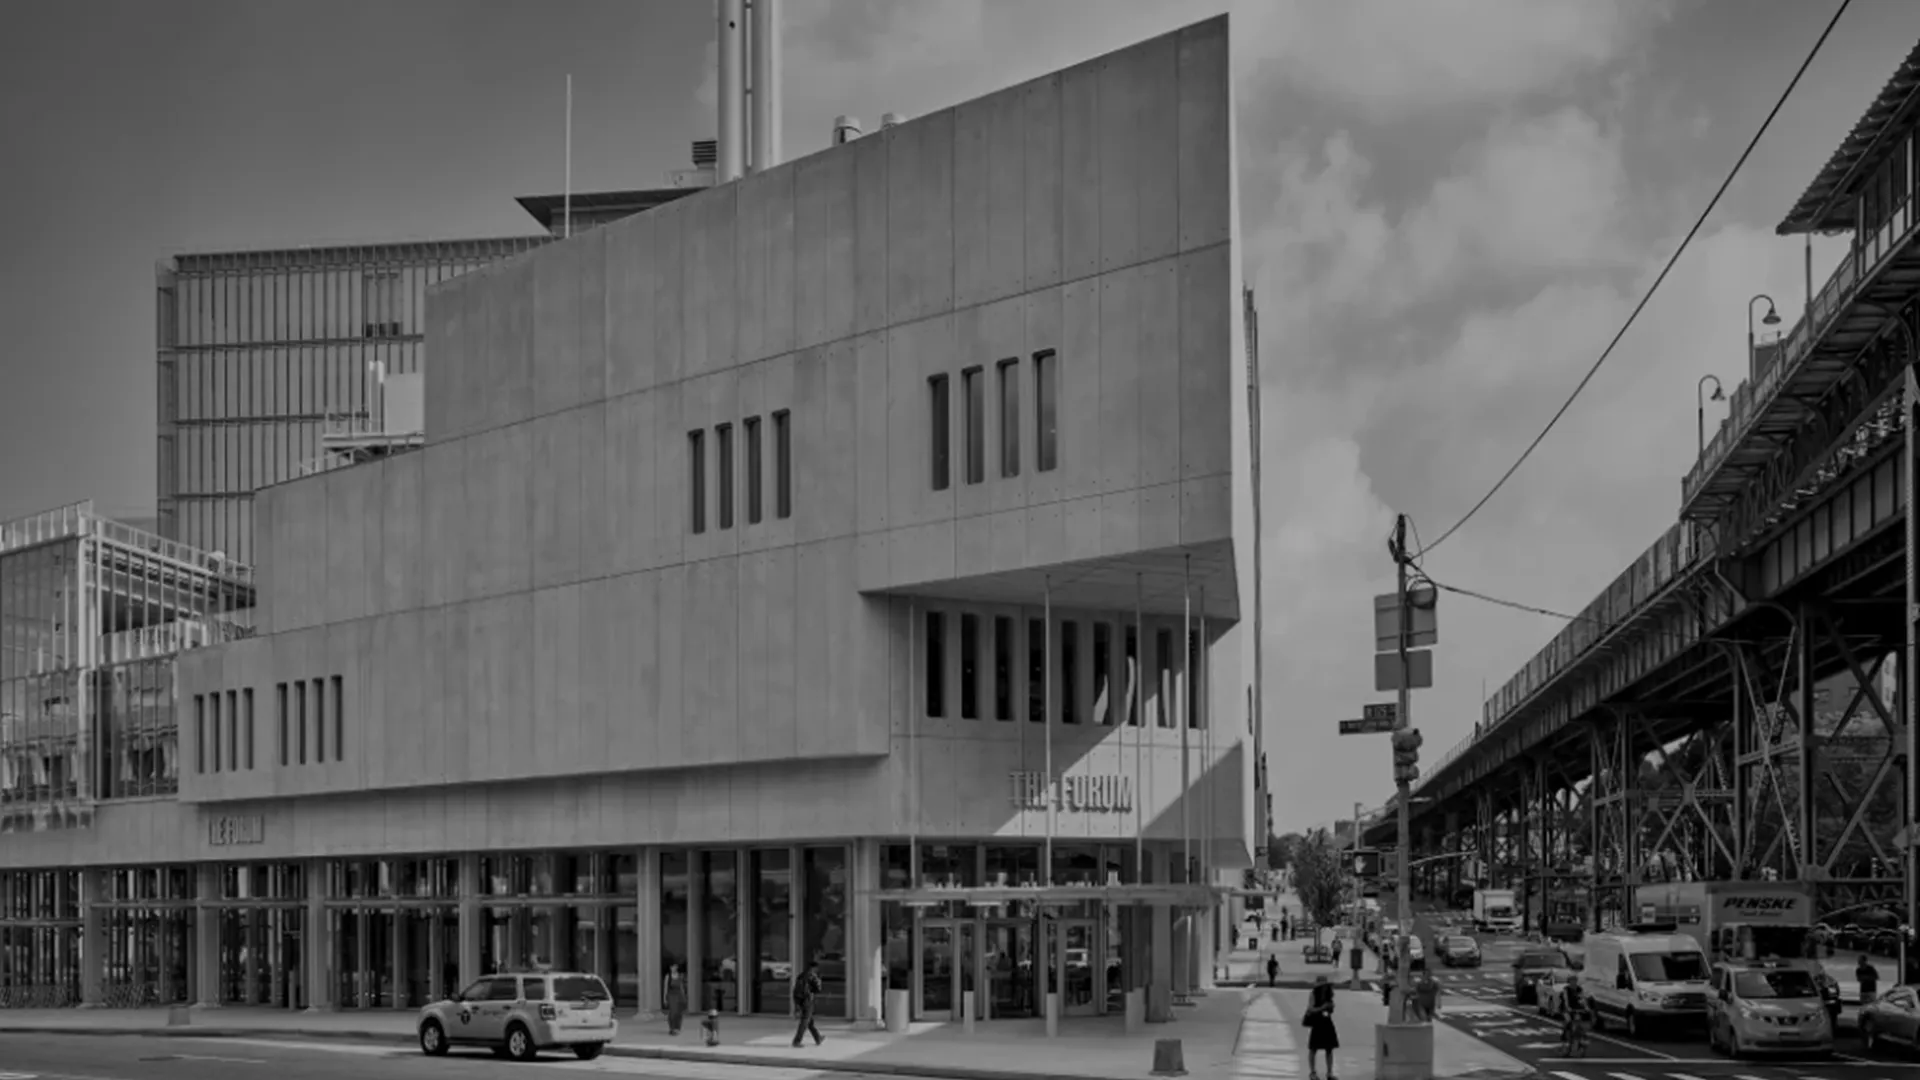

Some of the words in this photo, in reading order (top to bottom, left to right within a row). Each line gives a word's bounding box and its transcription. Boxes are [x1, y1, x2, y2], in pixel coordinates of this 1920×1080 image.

[1009, 771, 1058, 809] THE
[1062, 774, 1132, 811] FORUM
[1723, 896, 1797, 909] PENSKE
